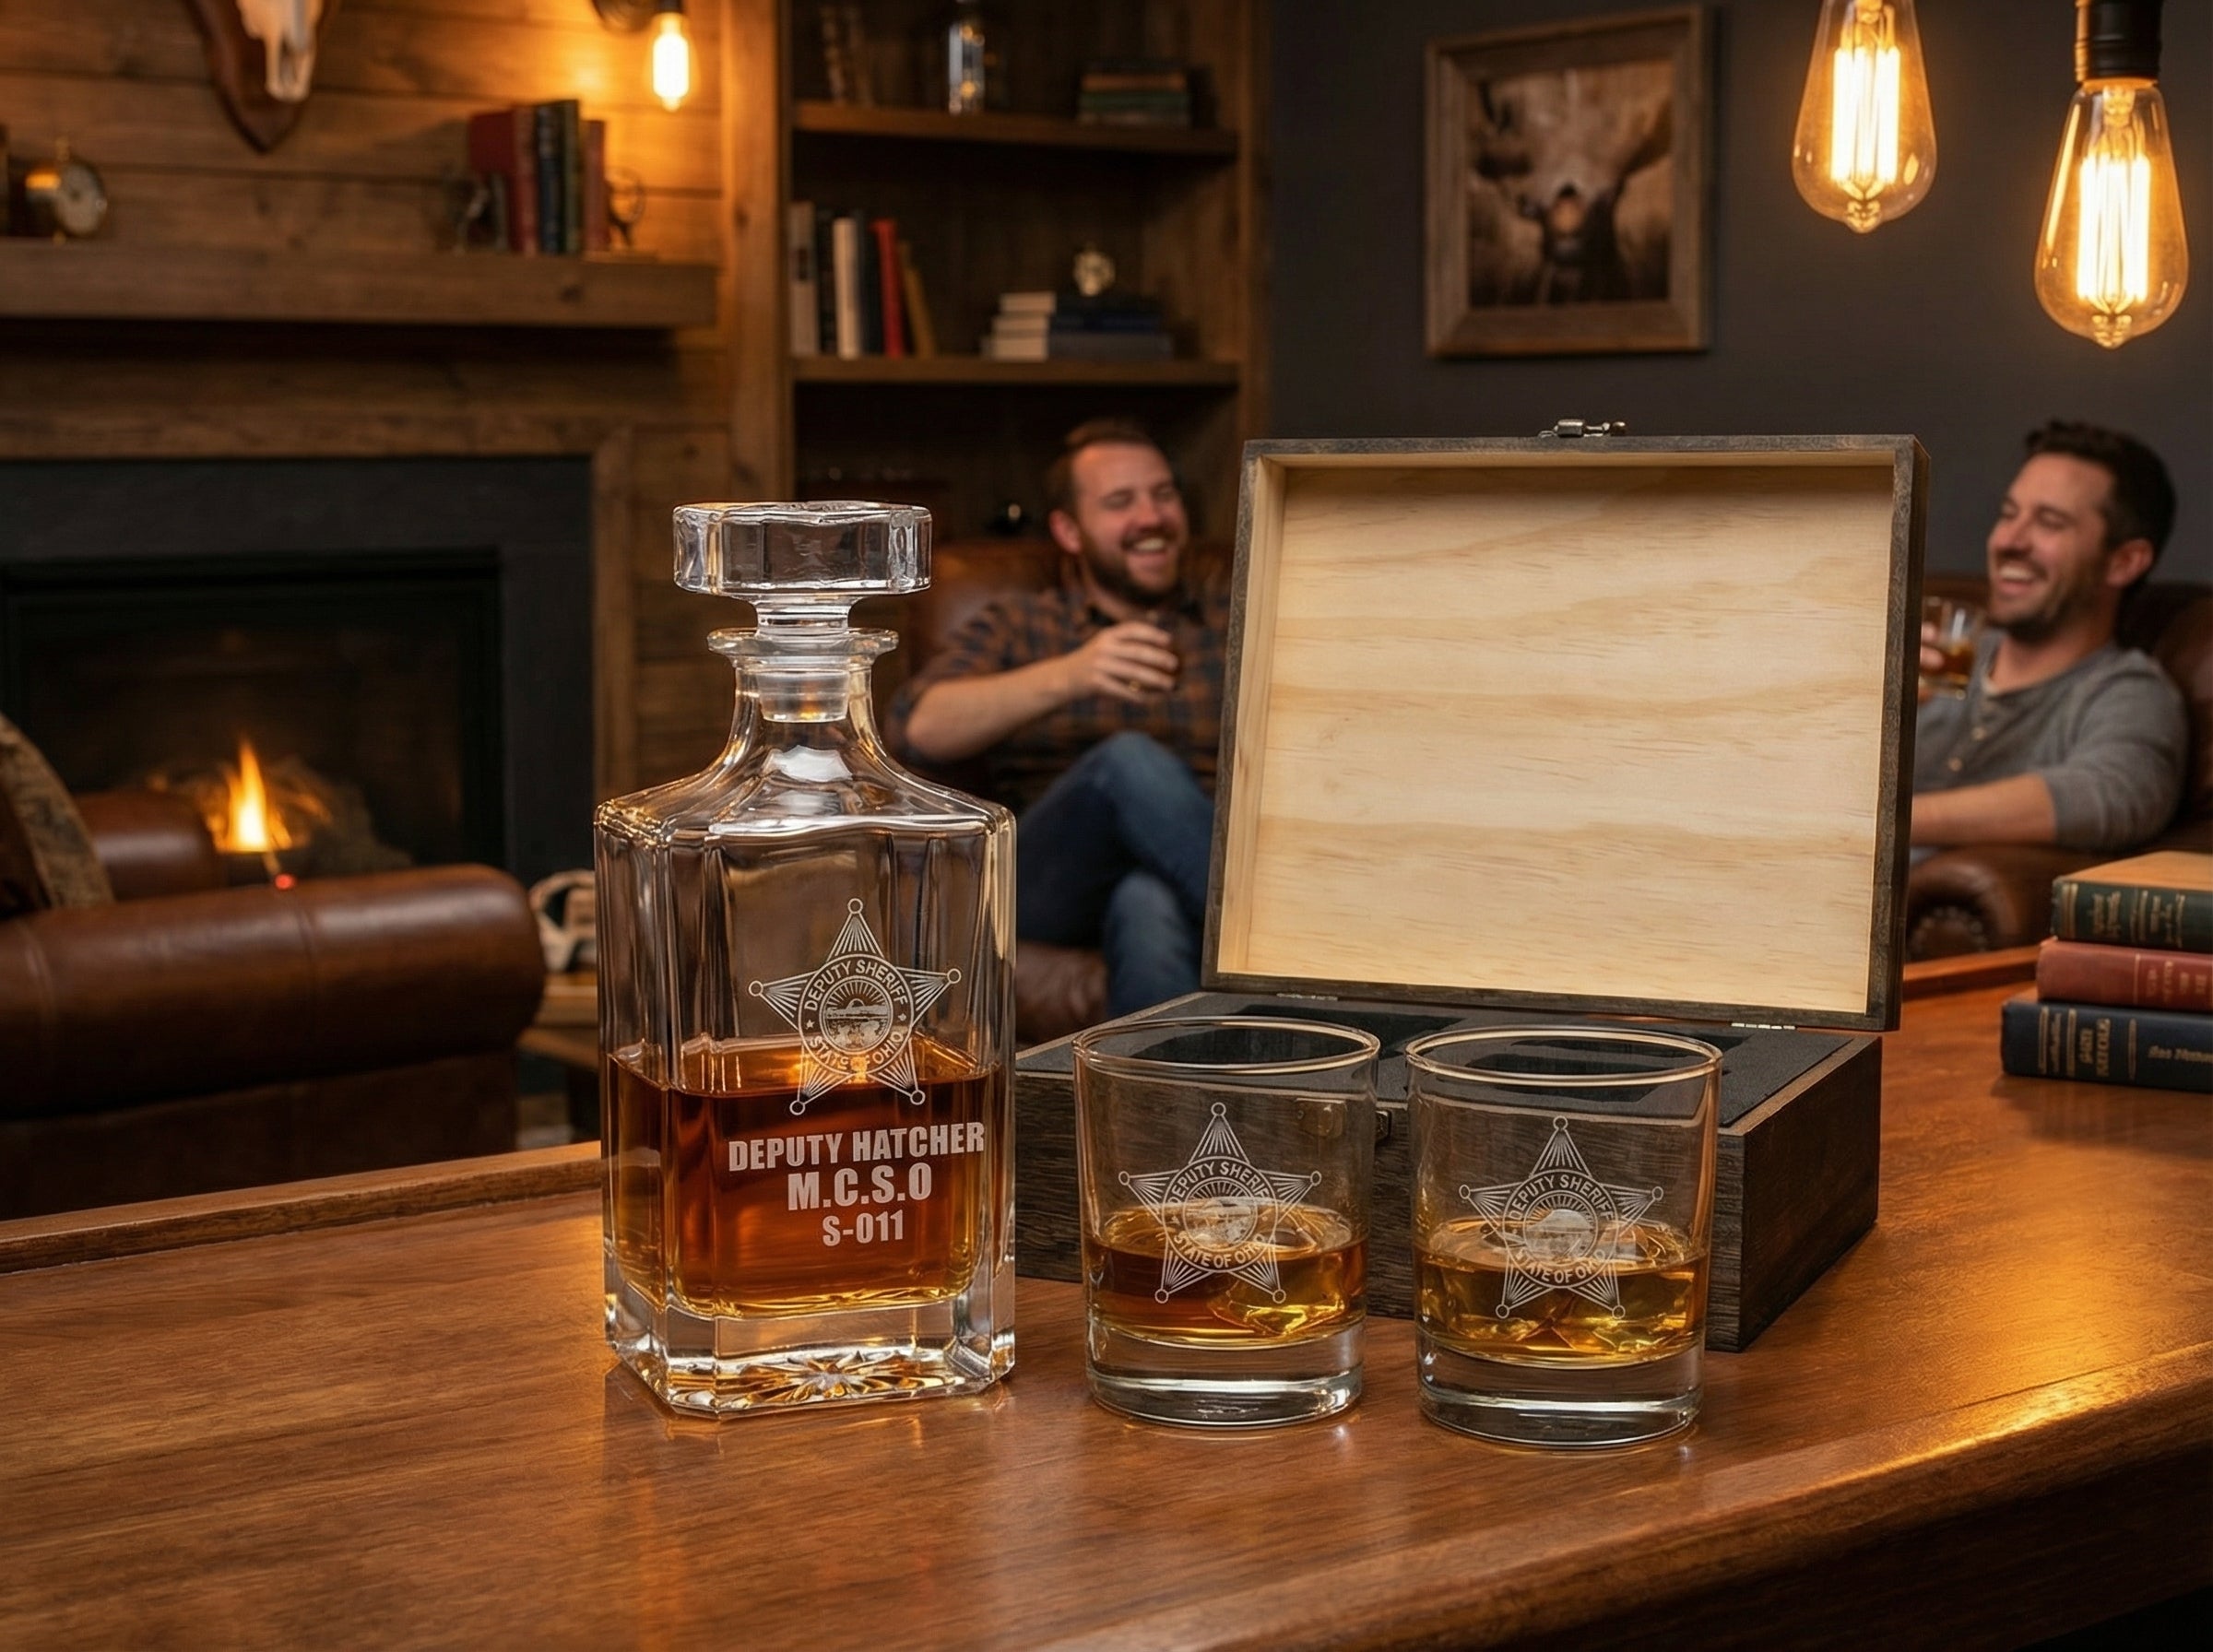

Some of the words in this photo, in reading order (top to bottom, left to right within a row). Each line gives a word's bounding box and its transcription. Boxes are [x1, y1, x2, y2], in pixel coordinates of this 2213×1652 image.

[804, 961, 852, 1011] DEPUTY
[855, 959, 908, 1006] SHERIFF
[872, 1031, 904, 1064] OHIO
[728, 1132, 843, 1172] DEPUTY
[852, 1121, 986, 1162] HATCHER
[787, 1162, 932, 1210] M.C.S.O
[1219, 1161, 1271, 1201] SHERIF
[1508, 1174, 1556, 1221] DEPUTY
[1559, 1174, 1615, 1221] SHERIFF
[822, 1210, 905, 1247] S-011
[1173, 1230, 1211, 1267] STATE
[1213, 1255, 1233, 1268] OF
[1554, 1269, 1574, 1284] OF
